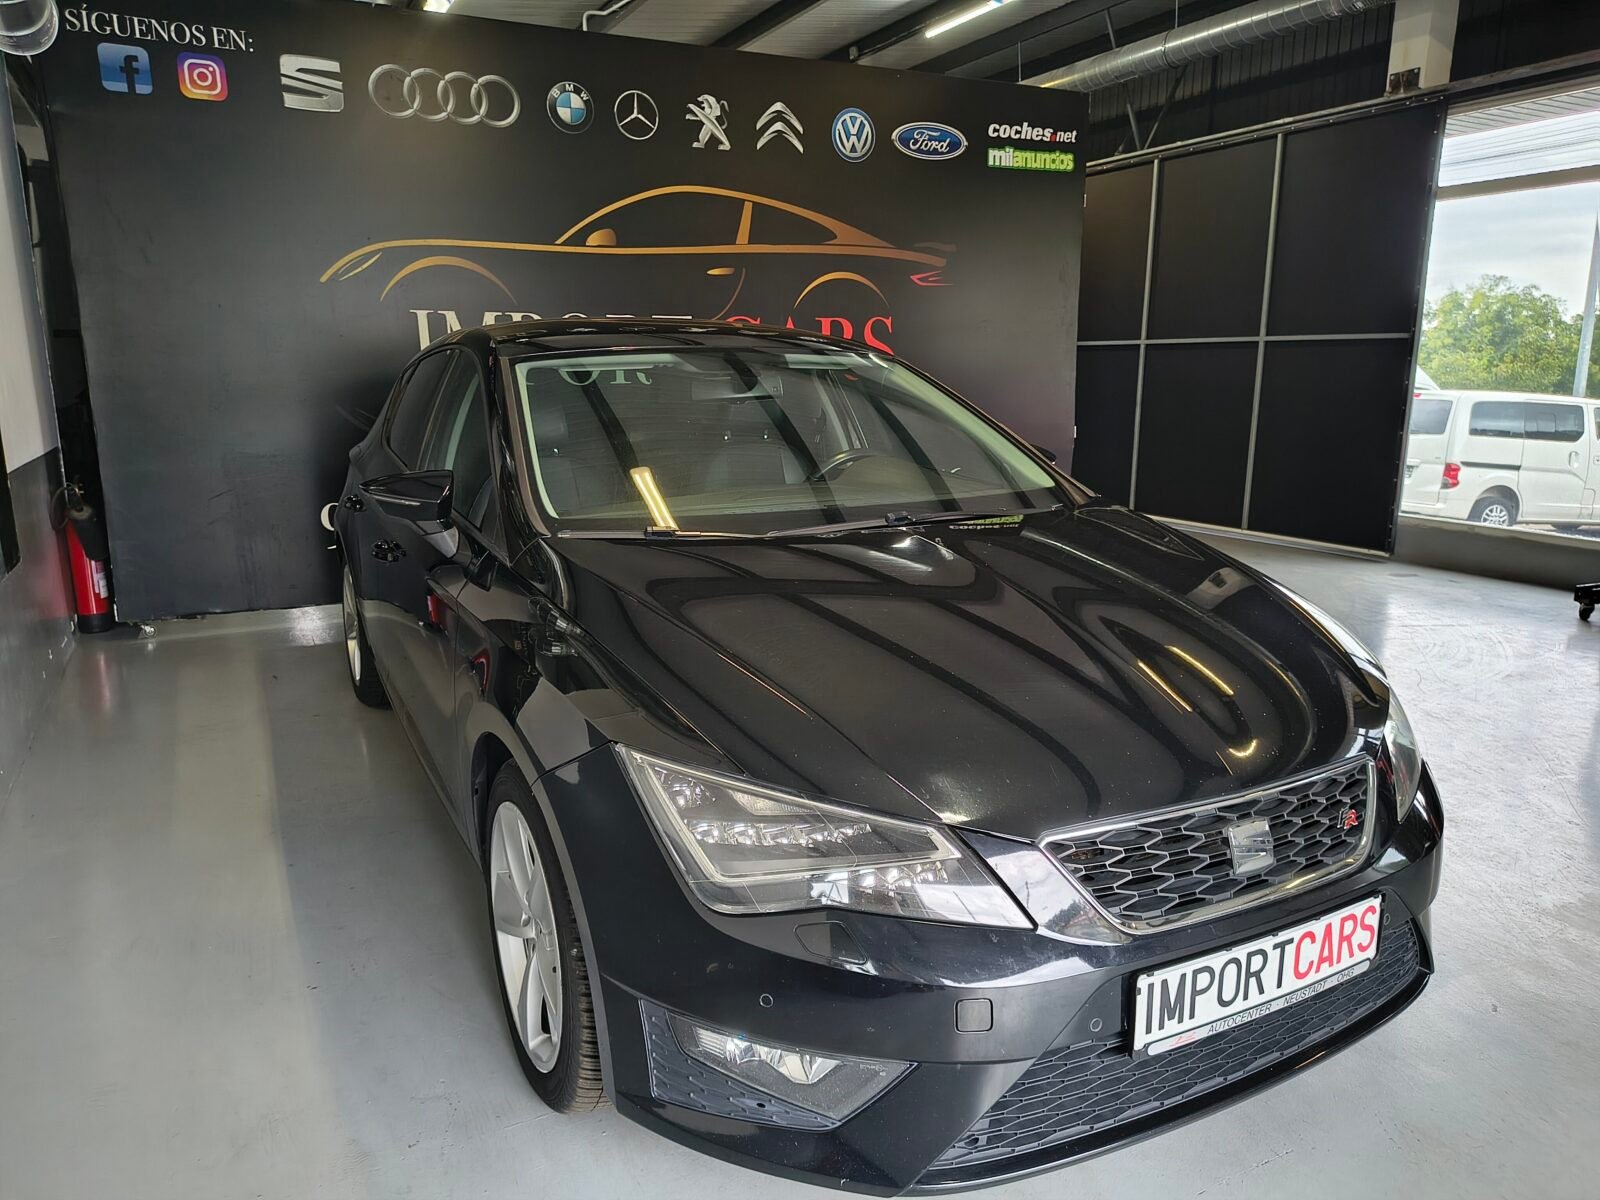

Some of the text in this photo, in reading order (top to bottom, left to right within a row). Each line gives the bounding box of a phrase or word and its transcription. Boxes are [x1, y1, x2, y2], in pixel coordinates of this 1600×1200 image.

[64, 4, 254, 52] SÍGUENOS EN:
[551, 83, 590, 101] BMW
[909, 128, 951, 153] Ford
[987, 121, 1078, 143] coches.net
[987, 145, 1075, 172] milanuncios
[1206, 967, 1356, 1035] AUTOCENTER NEUSTADT OHG
